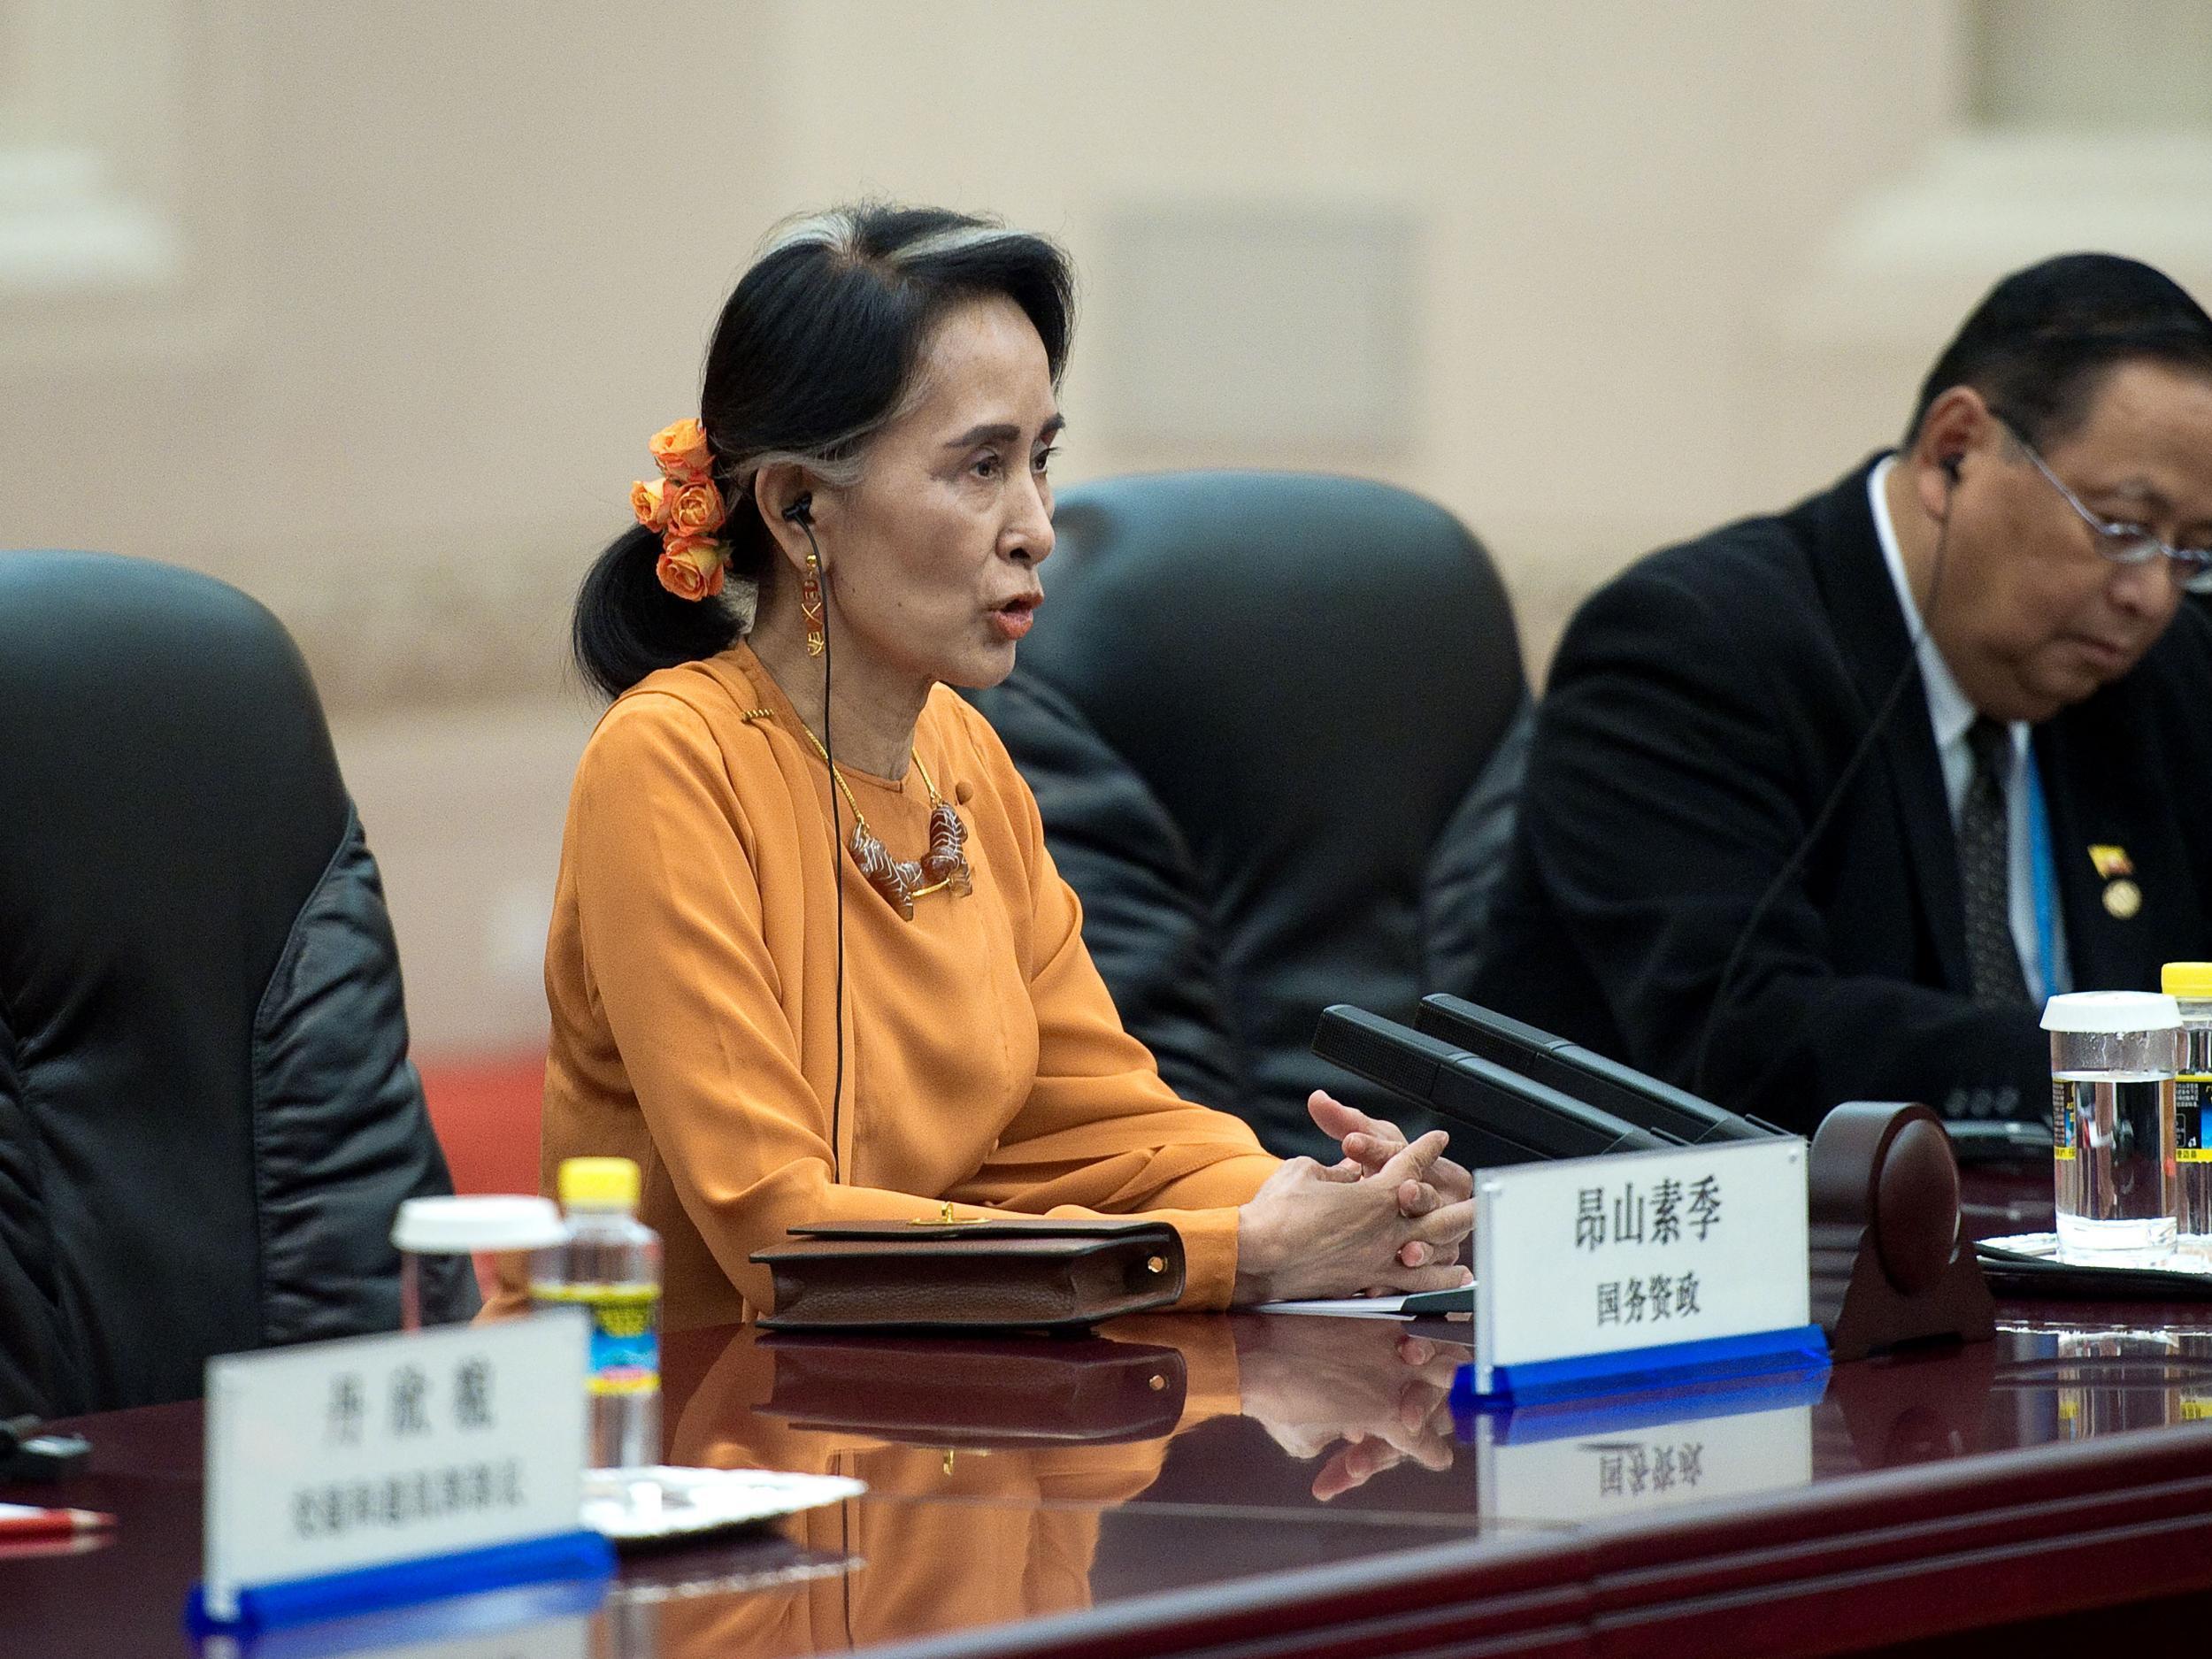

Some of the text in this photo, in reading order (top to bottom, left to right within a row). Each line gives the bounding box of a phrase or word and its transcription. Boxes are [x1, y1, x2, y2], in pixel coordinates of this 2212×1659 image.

[1575, 1174, 1723, 1251] 昂山素季
[1596, 1270, 1701, 1326] 国务资政
